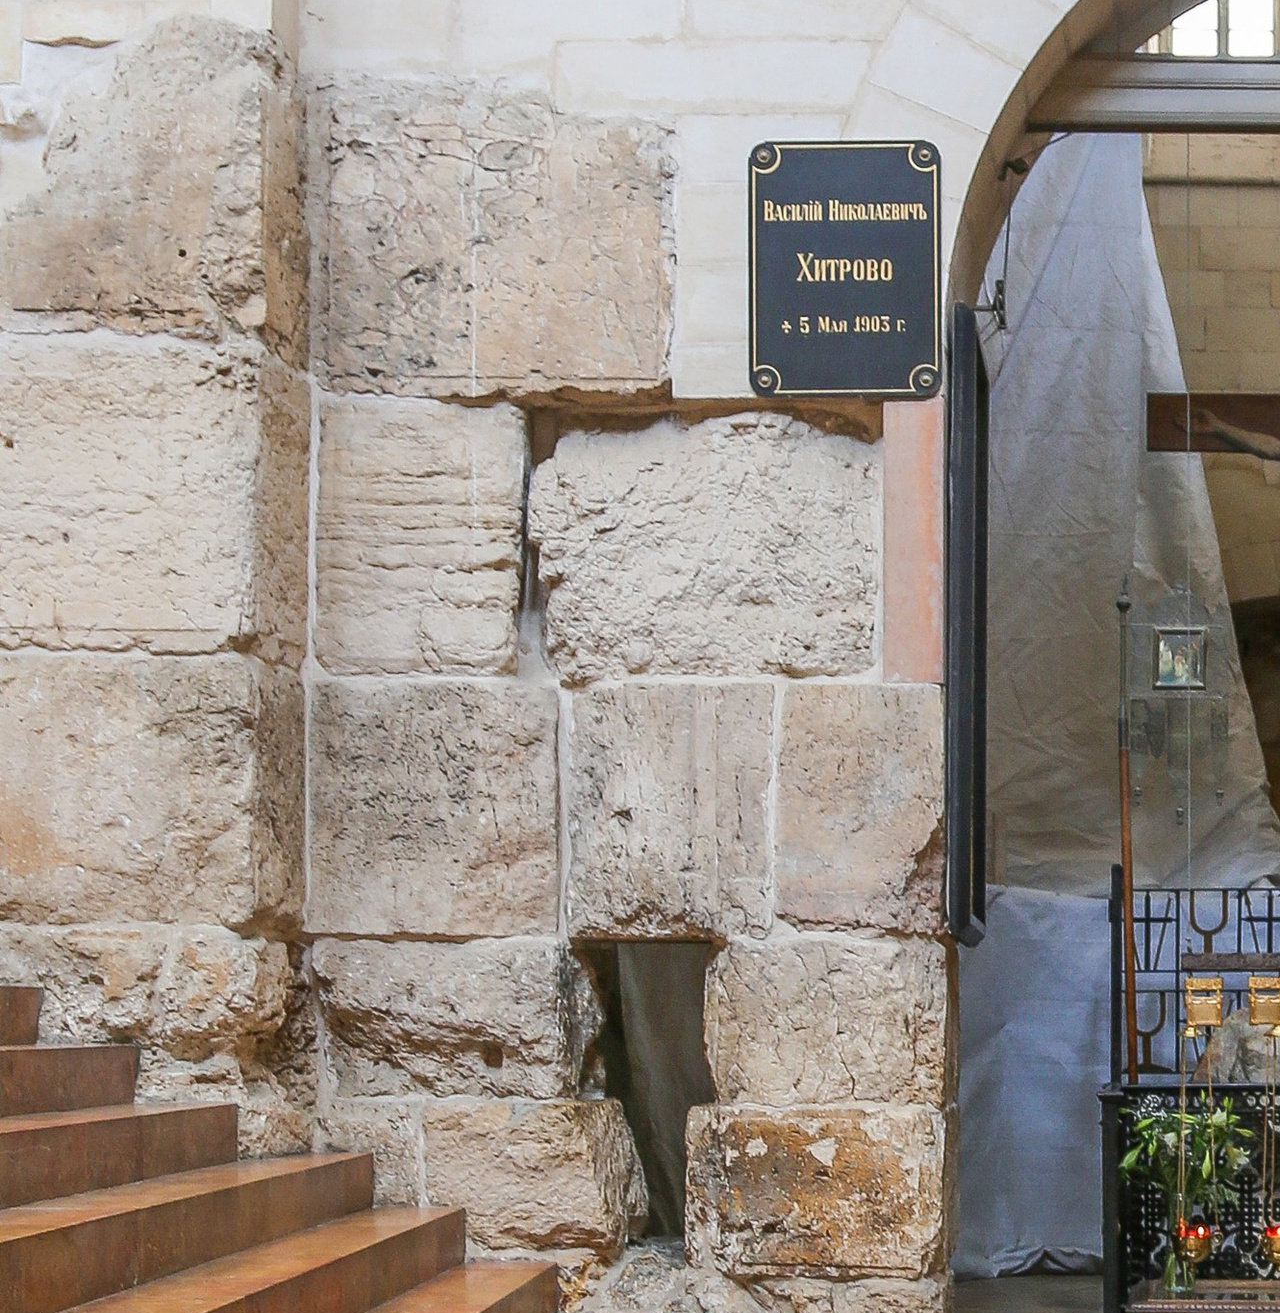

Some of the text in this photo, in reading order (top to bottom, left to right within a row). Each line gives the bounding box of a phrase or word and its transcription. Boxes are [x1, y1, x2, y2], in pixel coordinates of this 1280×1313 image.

[796, 253, 894, 282] Хитрово
[799, 317, 810, 334] 5
[853, 316, 891, 333] 1903
